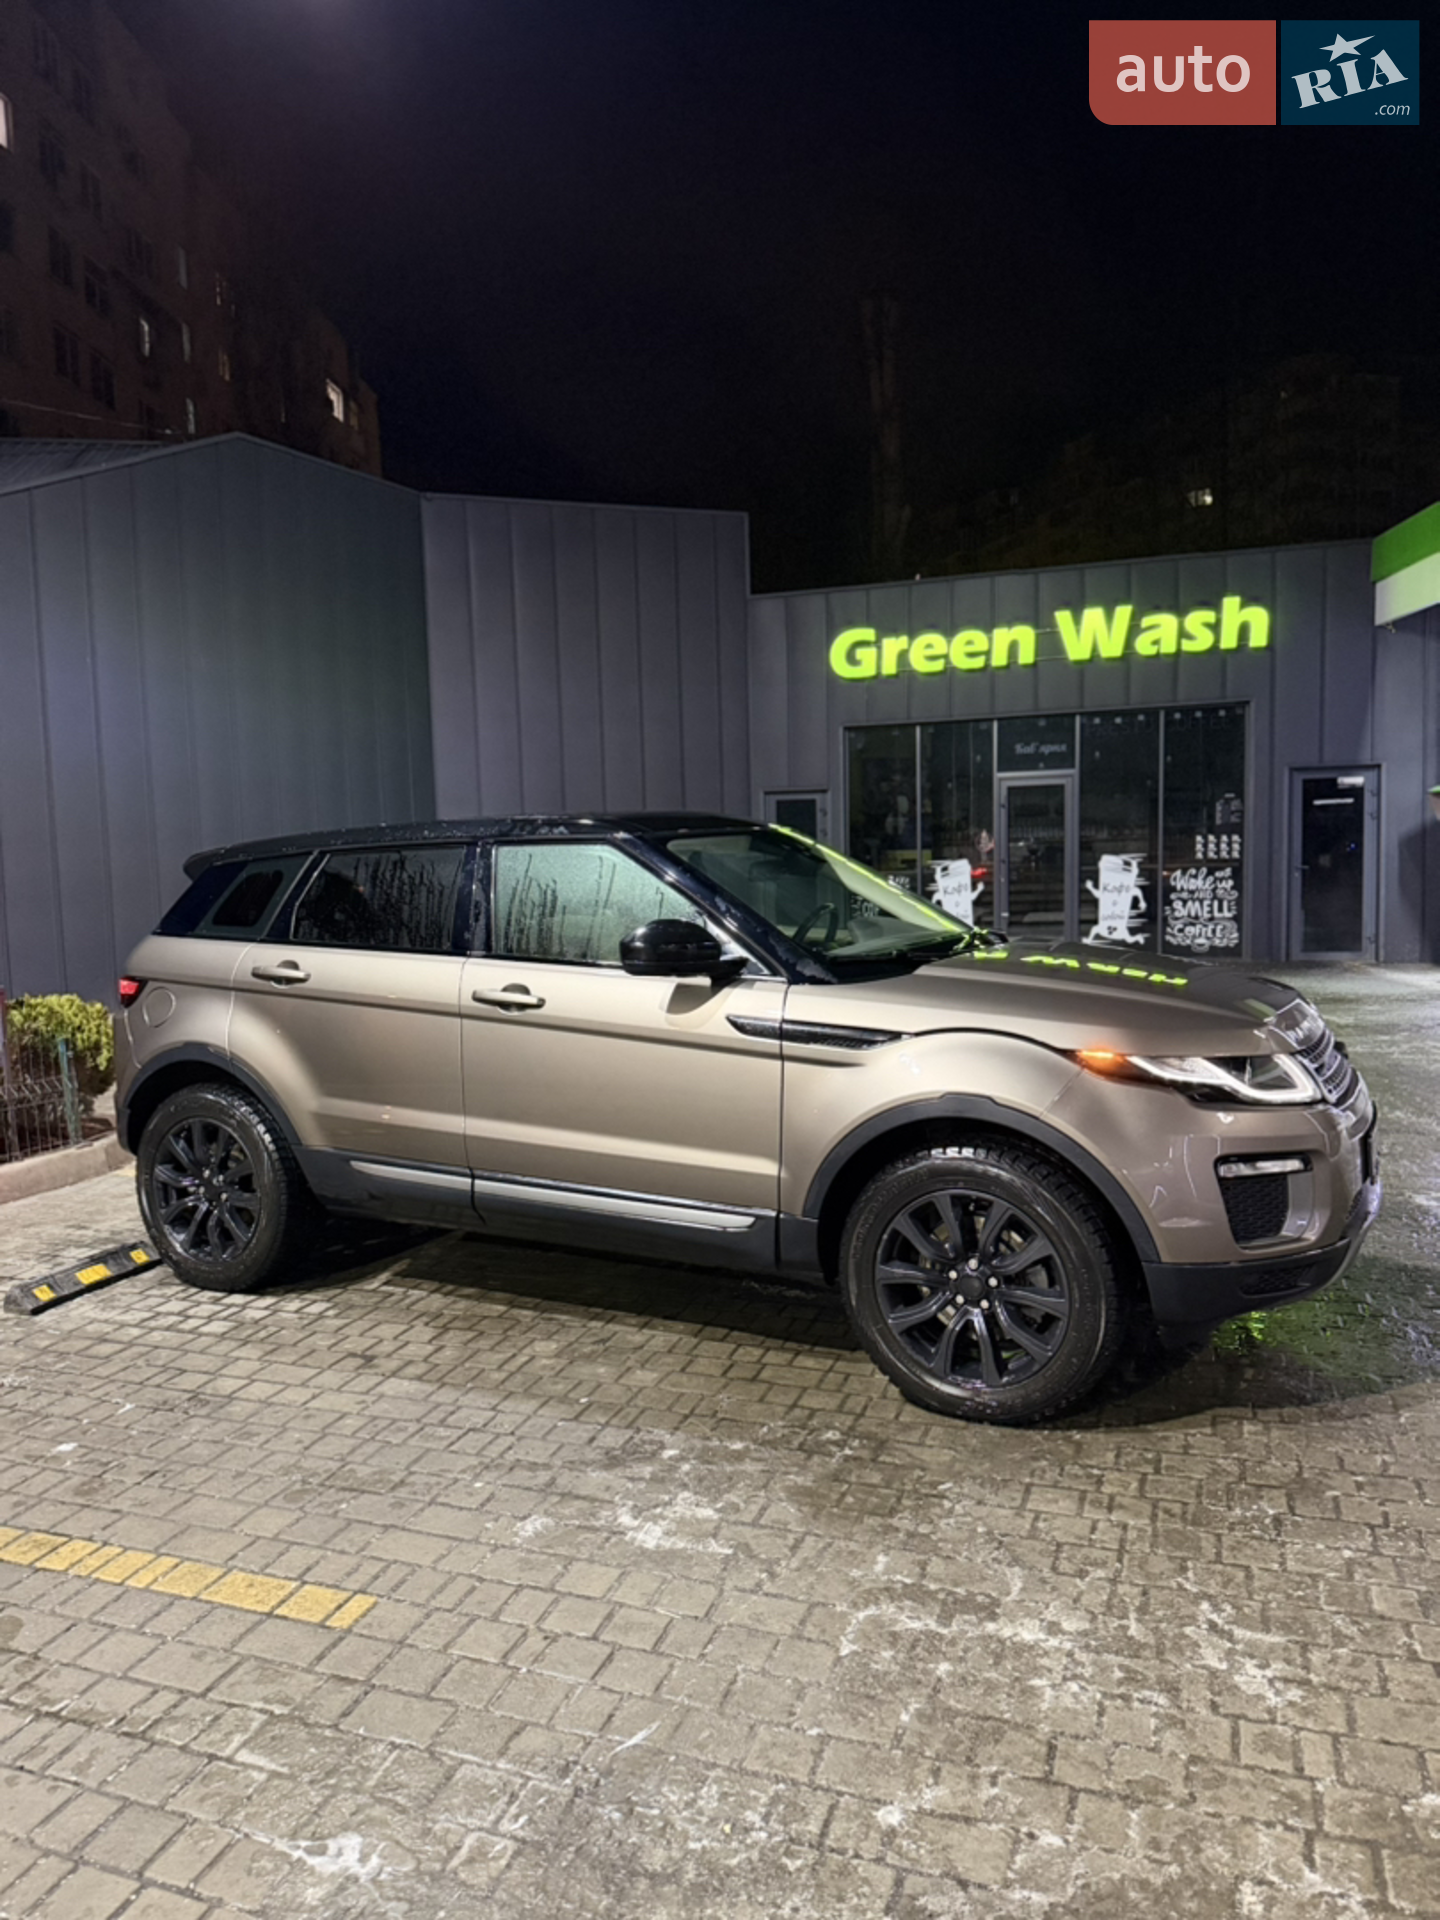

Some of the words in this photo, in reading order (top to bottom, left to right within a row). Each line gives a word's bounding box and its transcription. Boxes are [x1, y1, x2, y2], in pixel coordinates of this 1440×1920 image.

[829, 624, 1036, 680] Green
[1055, 596, 1270, 661] Wash
[1172, 899, 1233, 918] SMELL
